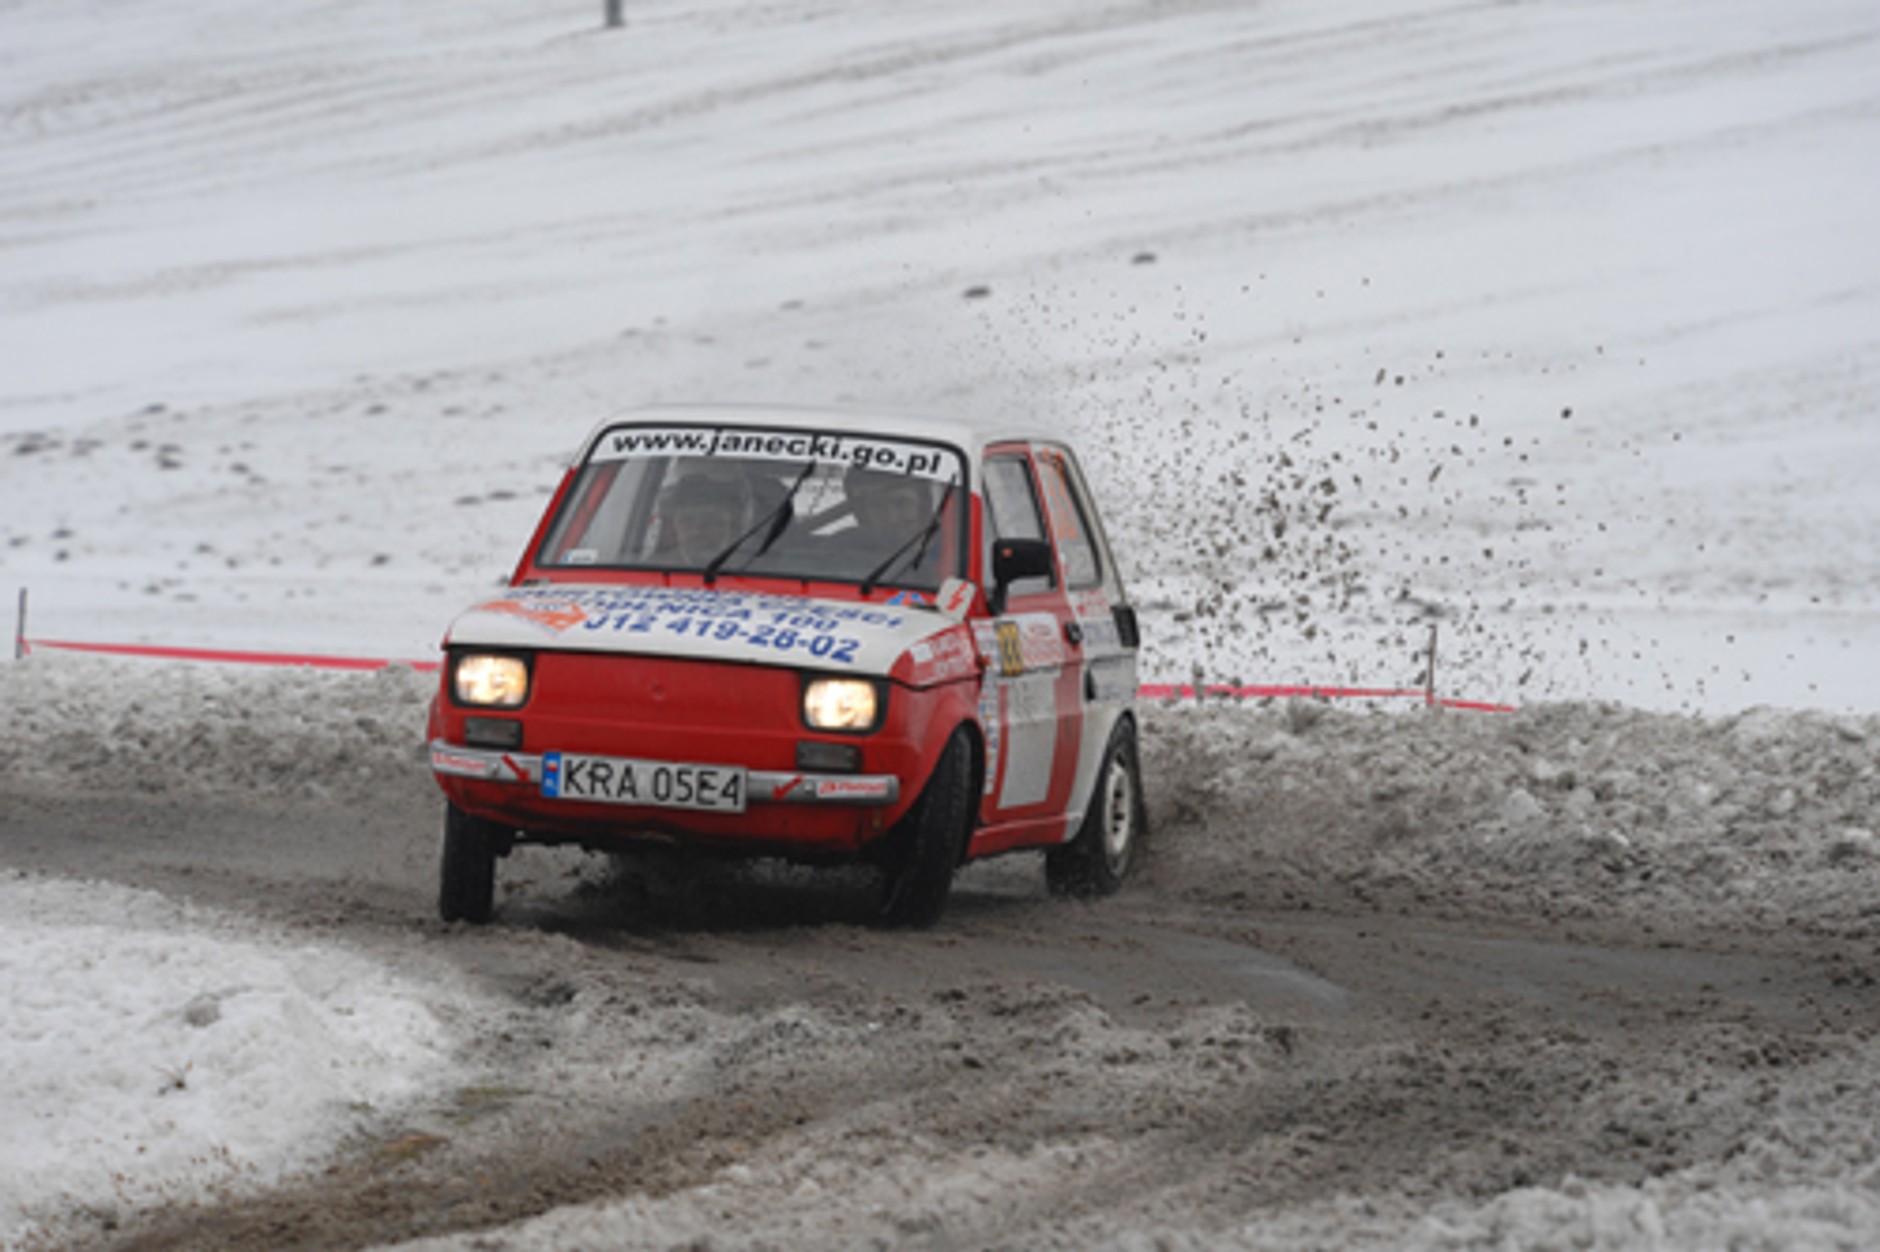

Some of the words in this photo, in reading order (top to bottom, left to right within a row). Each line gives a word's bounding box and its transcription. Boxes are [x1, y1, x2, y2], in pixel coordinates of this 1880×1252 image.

[613, 430, 941, 474] www.janecki.go.pl
[665, 616, 860, 663] 419-28-02
[564, 759, 638, 799] KRA
[652, 766, 742, 806] 05E4
